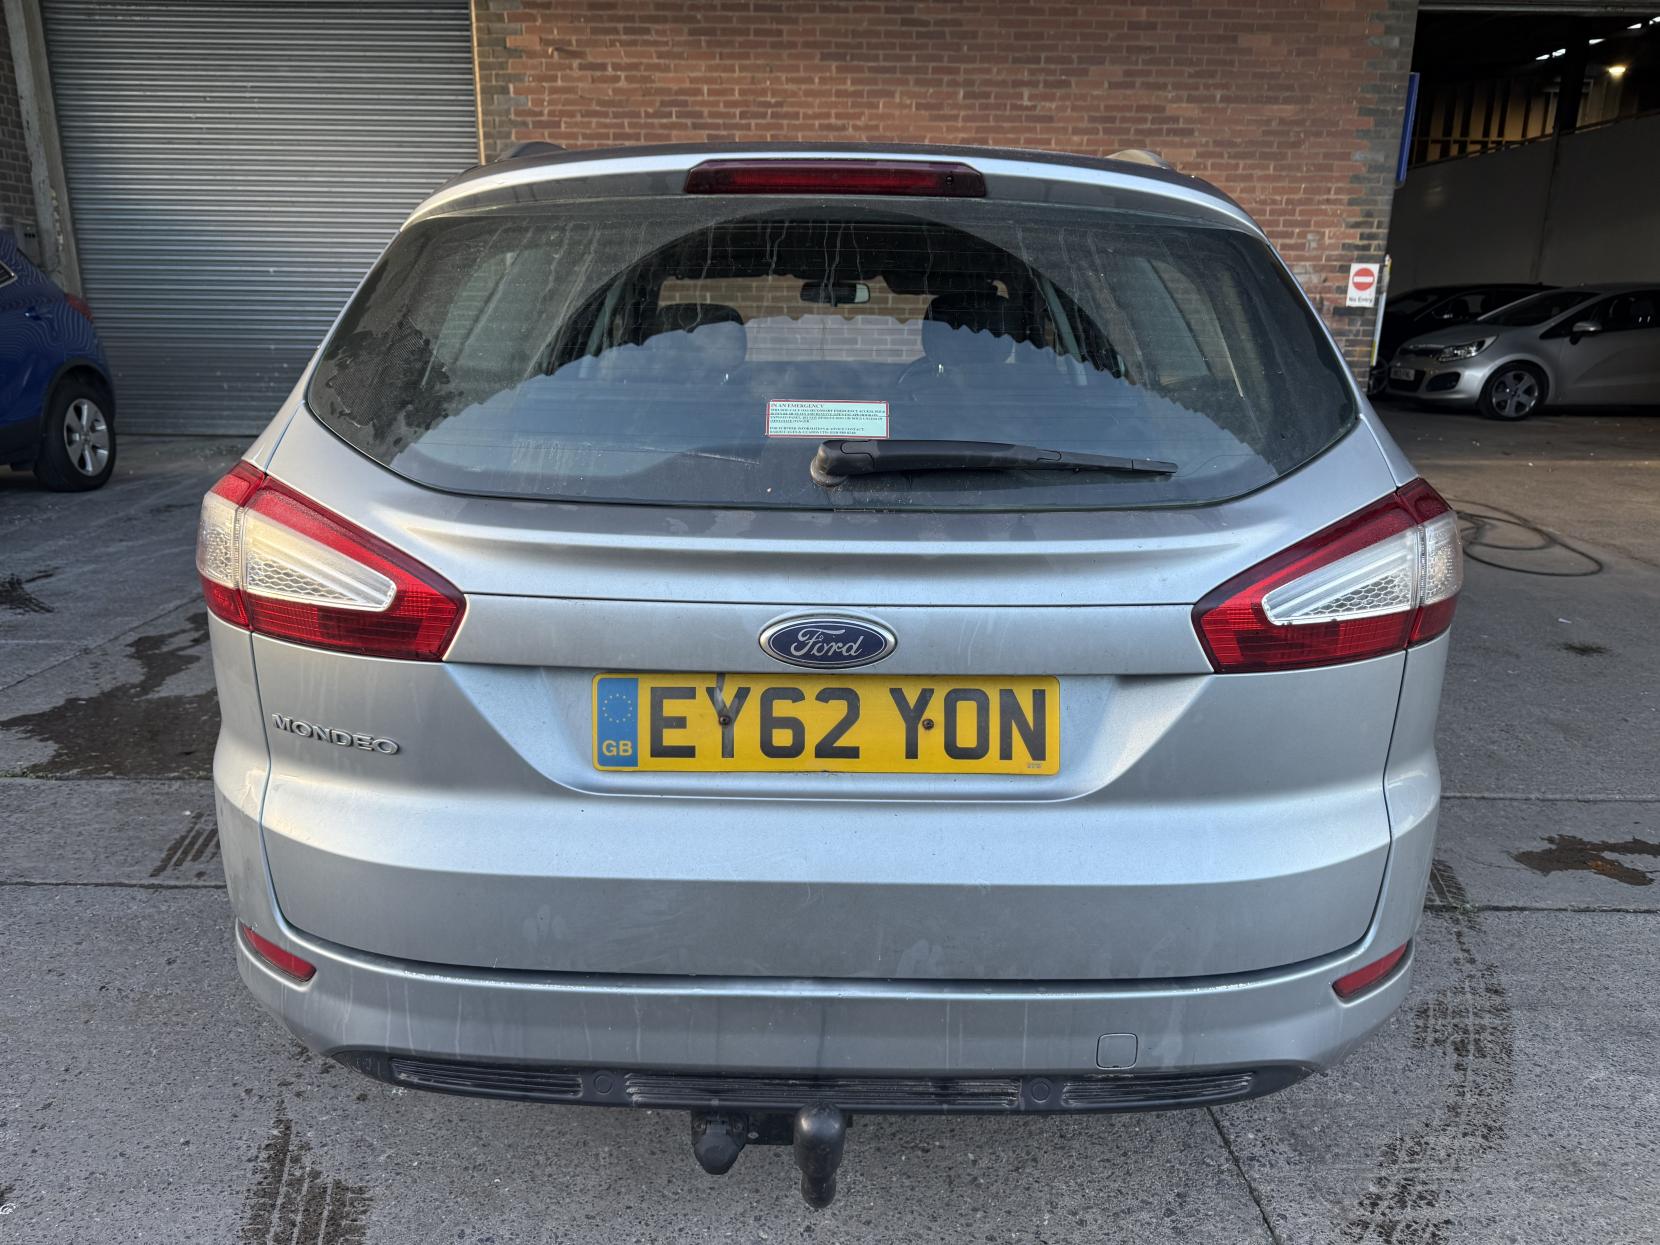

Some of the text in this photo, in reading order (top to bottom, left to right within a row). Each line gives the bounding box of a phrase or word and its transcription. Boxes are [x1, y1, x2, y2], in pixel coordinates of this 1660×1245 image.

[791, 627, 863, 659] Ford
[271, 712, 401, 756] MONDEO
[649, 686, 1047, 762] EY62 YON
[602, 739, 633, 757] GB
